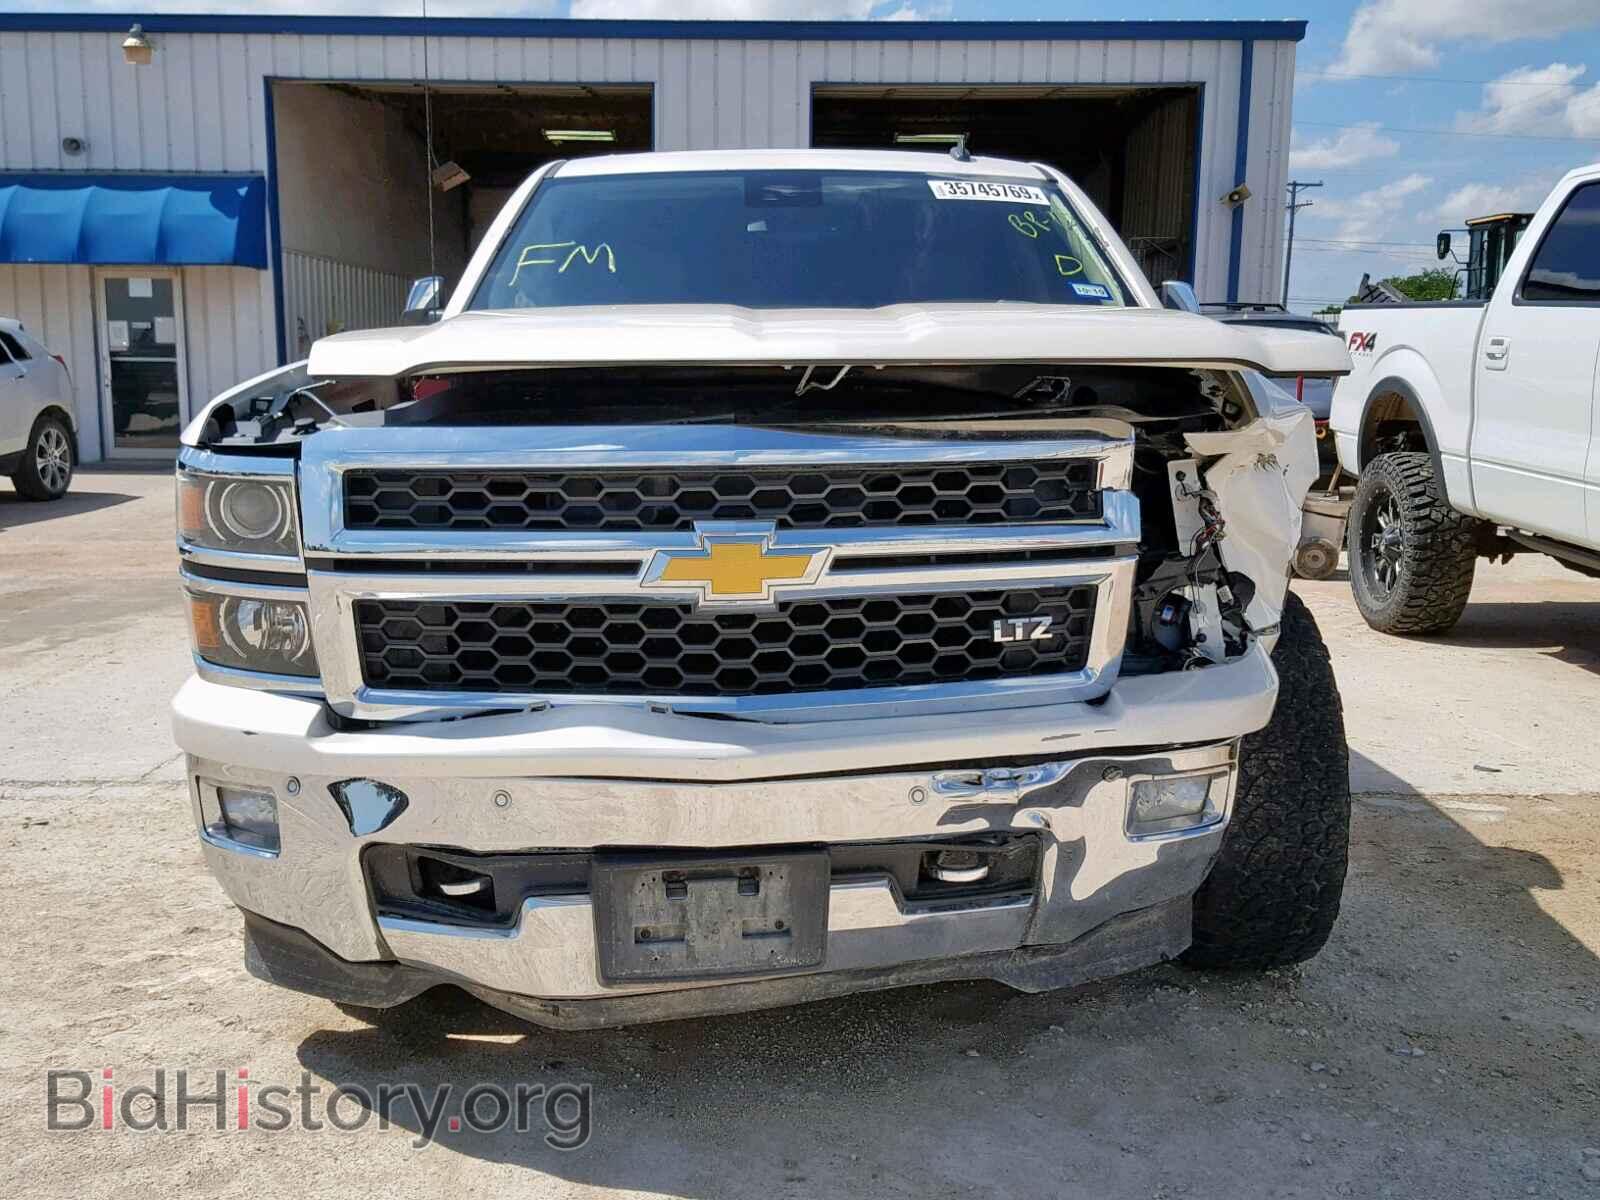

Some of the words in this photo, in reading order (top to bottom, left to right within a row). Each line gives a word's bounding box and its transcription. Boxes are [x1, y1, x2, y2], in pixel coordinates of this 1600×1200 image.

[944, 182, 1031, 199] 35745769
[508, 241, 617, 287] FM
[1054, 254, 1083, 276] D
[1348, 331, 1378, 352] FX4
[993, 616, 1053, 642] LTZ
